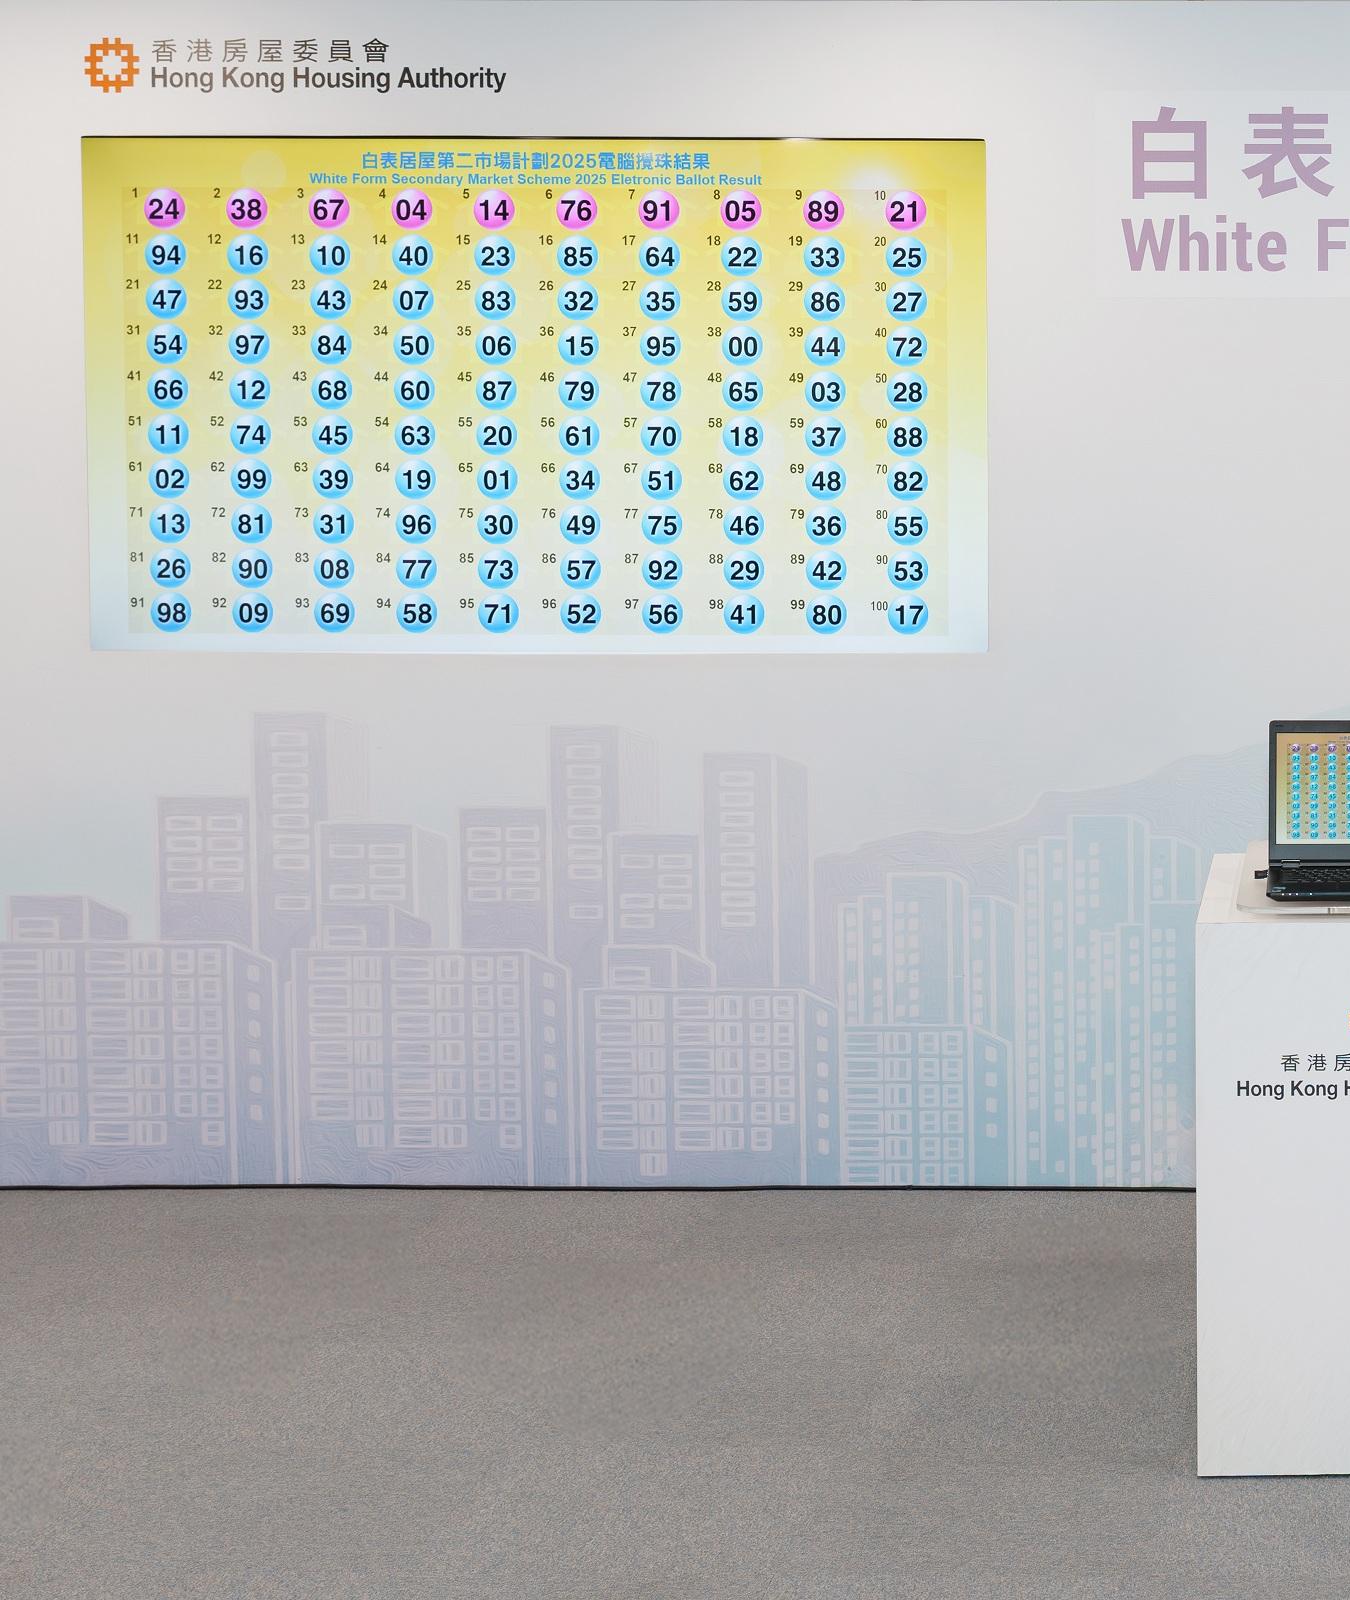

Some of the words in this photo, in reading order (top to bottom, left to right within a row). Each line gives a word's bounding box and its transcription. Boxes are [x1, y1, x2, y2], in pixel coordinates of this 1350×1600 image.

[151, 37, 390, 63] 香港房屋委員會
[151, 66, 214, 94] Hong
[222, 66, 285, 94] Kong
[292, 66, 391, 94] Housing
[397, 66, 507, 94] Authority
[309, 172, 347, 184] White
[351, 172, 387, 184] Form
[391, 172, 463, 187] Secondary
[467, 172, 514, 185] Market
[517, 173, 571, 185] Scheme
[575, 173, 607, 185] 2025
[611, 173, 672, 185] Eletronic
[675, 173, 716, 186] Ballot
[719, 174, 762, 186] Result
[132, 187, 138, 198] 1
[213, 187, 221, 199] 2
[297, 187, 305, 199] 3
[378, 188, 386, 199] 4
[462, 188, 470, 200] 5
[545, 188, 553, 200] 6
[628, 188, 636, 200] 7
[713, 189, 721, 200] 8
[795, 189, 803, 201] 9
[874, 190, 886, 201] 10
[148, 198, 180, 220] 24
[230, 198, 262, 221] 38
[313, 198, 345, 221] 67
[395, 199, 428, 221] 04
[479, 199, 510, 221] 14
[560, 199, 592, 222] 76
[642, 199, 670, 222] 91
[725, 200, 756, 222] 05
[807, 200, 839, 223] 89
[889, 200, 917, 223] 21
[1121, 214, 1287, 273] White
[151, 244, 182, 266] 94
[235, 245, 264, 266] 16
[317, 245, 346, 266] 10
[398, 245, 428, 267] 40
[481, 246, 511, 267] 23
[563, 246, 593, 267] 85
[645, 246, 675, 268] 64
[727, 246, 757, 267] 22
[810, 247, 840, 268] 33
[892, 247, 922, 268] 25
[152, 289, 182, 310] 47
[234, 289, 264, 311] 93
[316, 290, 346, 311] 43
[399, 290, 429, 311] 07
[481, 290, 511, 311] 83
[564, 290, 594, 312] 32
[646, 291, 676, 312] 35
[728, 291, 758, 312] 59
[810, 291, 841, 313] 86
[892, 291, 922, 312] 27
[153, 334, 183, 355] 54
[235, 334, 265, 356] 97
[317, 335, 347, 356] 84
[400, 335, 430, 356] 50
[482, 335, 512, 356] 06
[565, 335, 594, 357] 15
[646, 336, 676, 357] 95
[728, 336, 758, 357] 00
[810, 336, 841, 357] 44
[892, 336, 923, 357] 72
[154, 379, 183, 400] 66
[237, 379, 266, 400] 12
[318, 380, 348, 401] 68
[400, 380, 430, 401] 60
[482, 380, 512, 401] 87
[564, 380, 595, 402] 79
[646, 381, 676, 402] 78
[729, 381, 758, 402] 65
[811, 381, 841, 403] 03
[893, 381, 923, 403] 28
[155, 424, 180, 445] 11
[236, 424, 266, 445] 74
[318, 425, 348, 446] 45
[401, 425, 431, 446] 63
[483, 425, 512, 447] 20
[565, 425, 591, 447] 61
[647, 426, 677, 447] 70
[730, 426, 759, 447] 18
[811, 426, 841, 448] 37
[893, 426, 923, 448] 88
[155, 468, 185, 489] 02
[237, 469, 267, 490] 99
[319, 469, 349, 490] 39
[402, 469, 431, 490] 19
[483, 469, 509, 491] 01
[565, 470, 596, 491] 34
[647, 470, 673, 491] 51
[729, 470, 759, 492] 62
[811, 470, 841, 492] 48
[893, 471, 923, 492] 82
[157, 513, 185, 534] 13
[237, 513, 264, 535] 81
[319, 514, 345, 535] 31
[402, 514, 432, 535] 96
[484, 514, 513, 536] 30
[566, 514, 596, 536] 49
[647, 515, 678, 536] 75
[729, 515, 760, 536] 46
[812, 515, 842, 537] 36
[894, 516, 923, 537] 55
[156, 558, 186, 579] 26
[238, 558, 268, 580] 90
[320, 558, 350, 580] 08
[402, 559, 432, 580] 77
[484, 559, 514, 580] 73
[566, 560, 596, 581] 57
[648, 559, 678, 581] 92
[730, 560, 760, 581] 29
[812, 560, 842, 581] 42
[894, 560, 924, 582] 53
[131, 596, 144, 608] 91
[212, 597, 227, 608] 92
[295, 597, 310, 609] 93
[376, 597, 392, 609] 94
[459, 598, 475, 609] 95
[542, 598, 557, 609] 96
[624, 598, 639, 610] 97
[709, 599, 724, 610] 98
[790, 599, 805, 610] 99
[871, 600, 889, 611] 100
[157, 602, 187, 624] 98
[239, 602, 268, 624] 09
[320, 602, 350, 624] 69
[402, 603, 433, 624] 58
[484, 603, 510, 624] 71
[567, 603, 597, 625] 52
[648, 603, 678, 625] 56
[730, 604, 756, 625] 41
[812, 604, 842, 626] 80
[895, 605, 924, 625] 17
[1236, 1079, 1285, 1100] Hong
[1290, 1079, 1338, 1100] Kong
